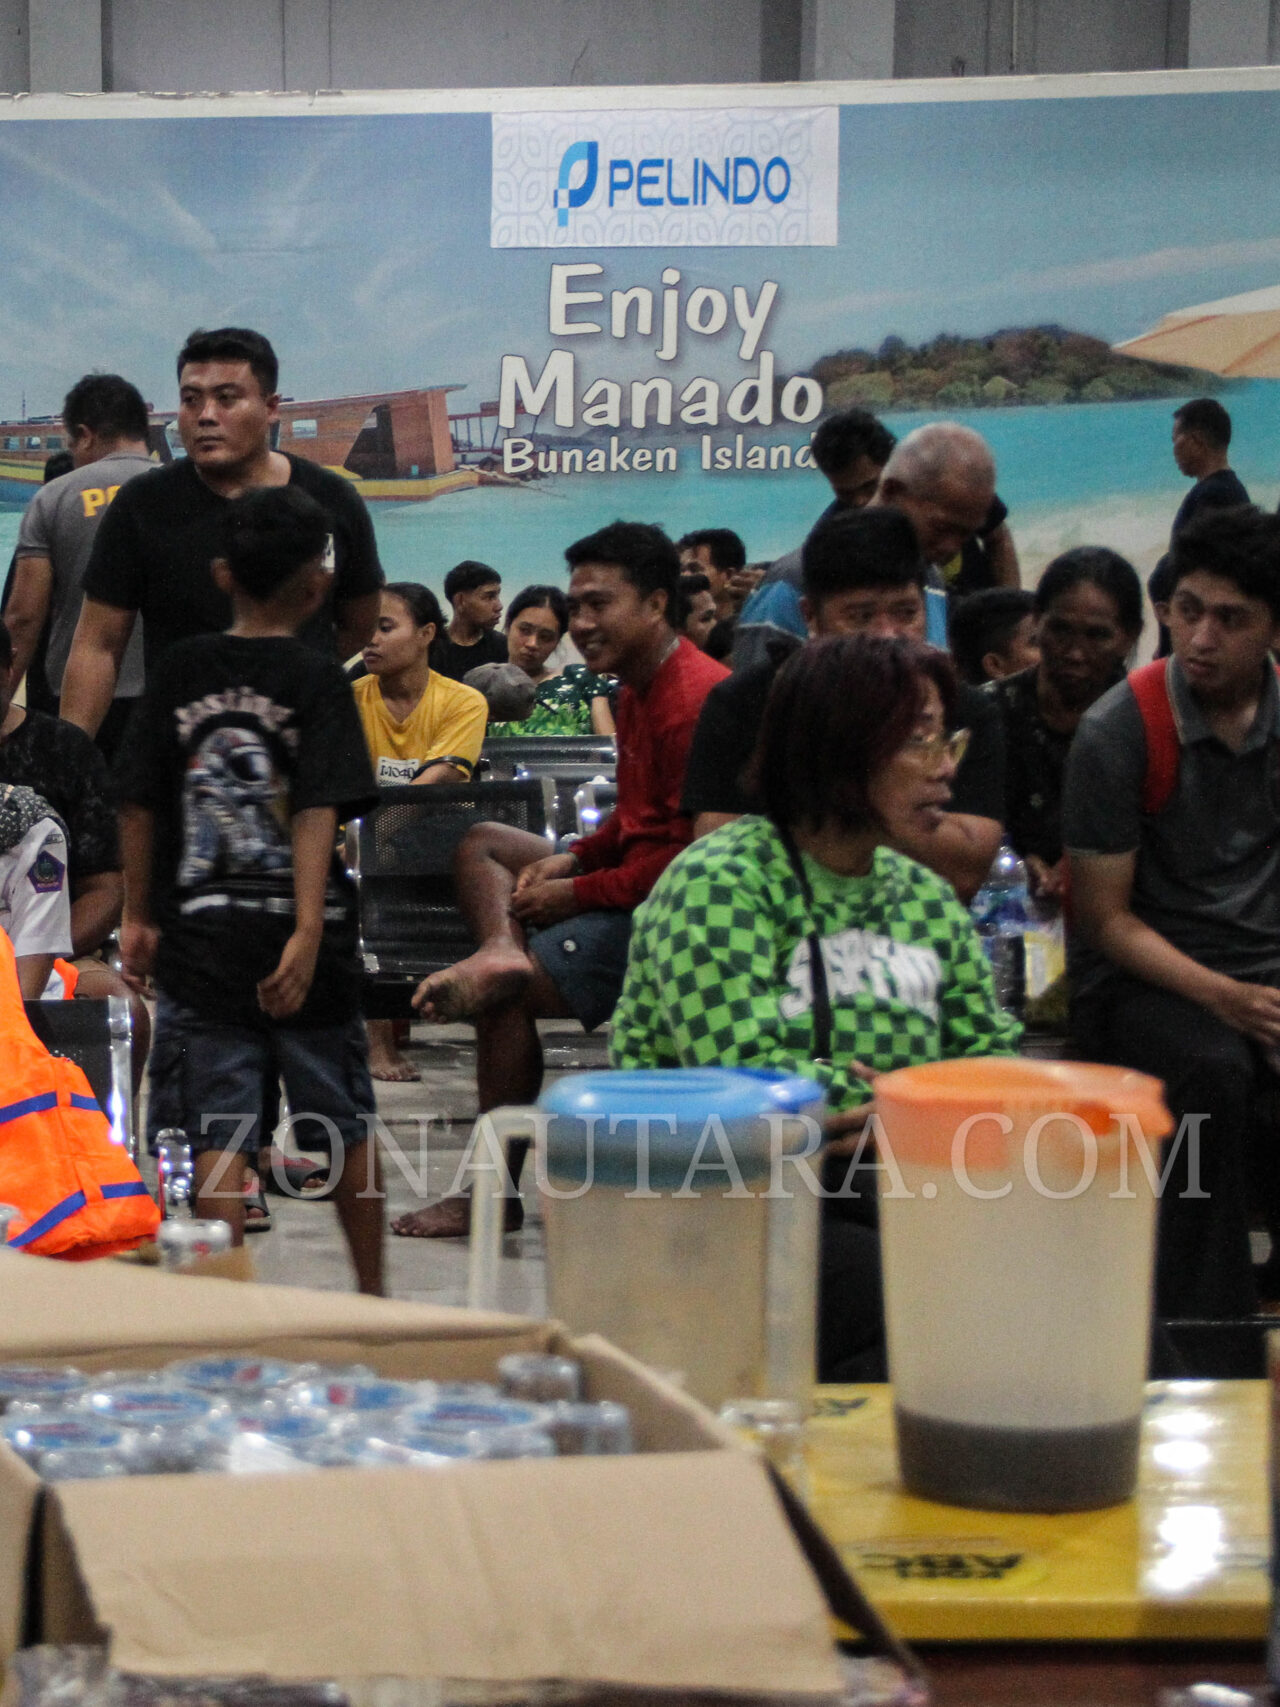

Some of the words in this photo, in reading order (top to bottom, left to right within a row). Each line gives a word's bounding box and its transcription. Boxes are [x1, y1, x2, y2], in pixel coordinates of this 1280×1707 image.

[608, 155, 792, 208] PELINDO
[549, 263, 778, 361] Enjoy
[498, 349, 822, 429] Manado
[502, 436, 677, 474] Bunaken
[701, 432, 818, 470] Island
